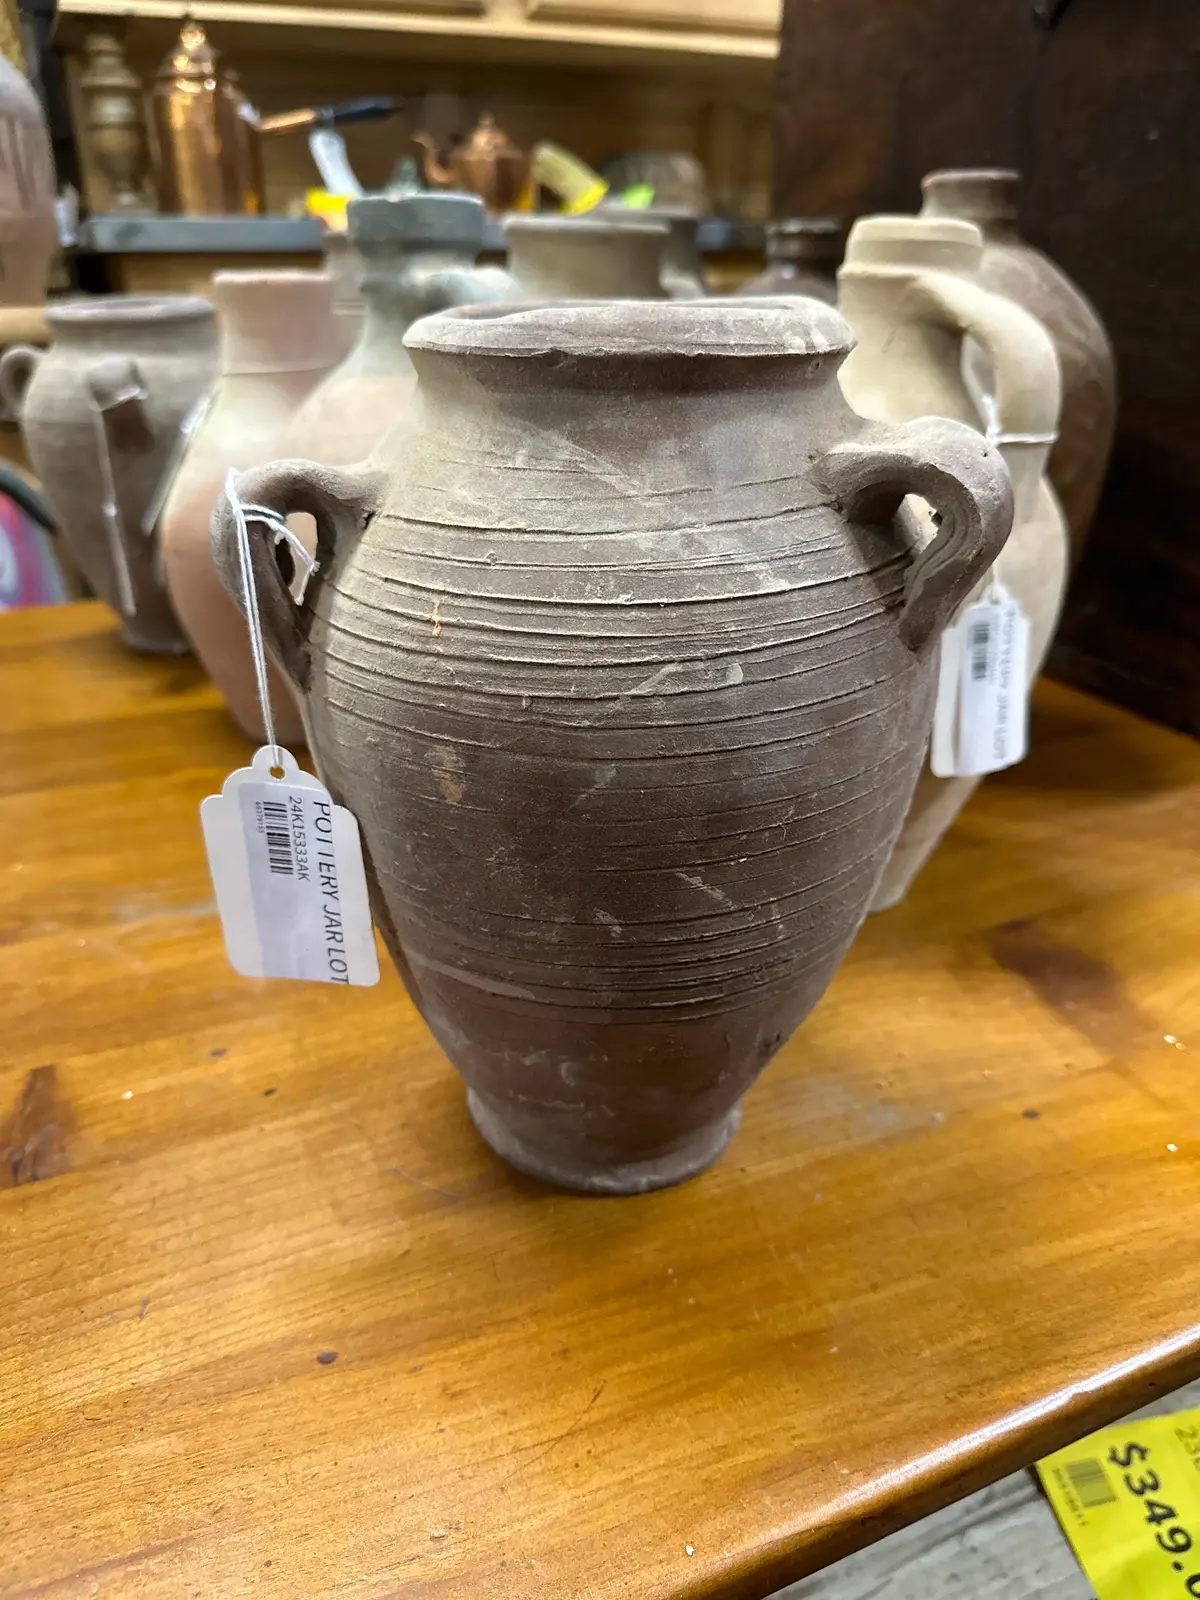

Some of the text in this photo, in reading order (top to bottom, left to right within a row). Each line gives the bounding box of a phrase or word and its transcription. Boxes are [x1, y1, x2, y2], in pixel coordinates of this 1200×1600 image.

[289, 796, 311, 881] 24K15333AK
[322, 904, 344, 944] JAR
[327, 946, 350, 985] LOT
